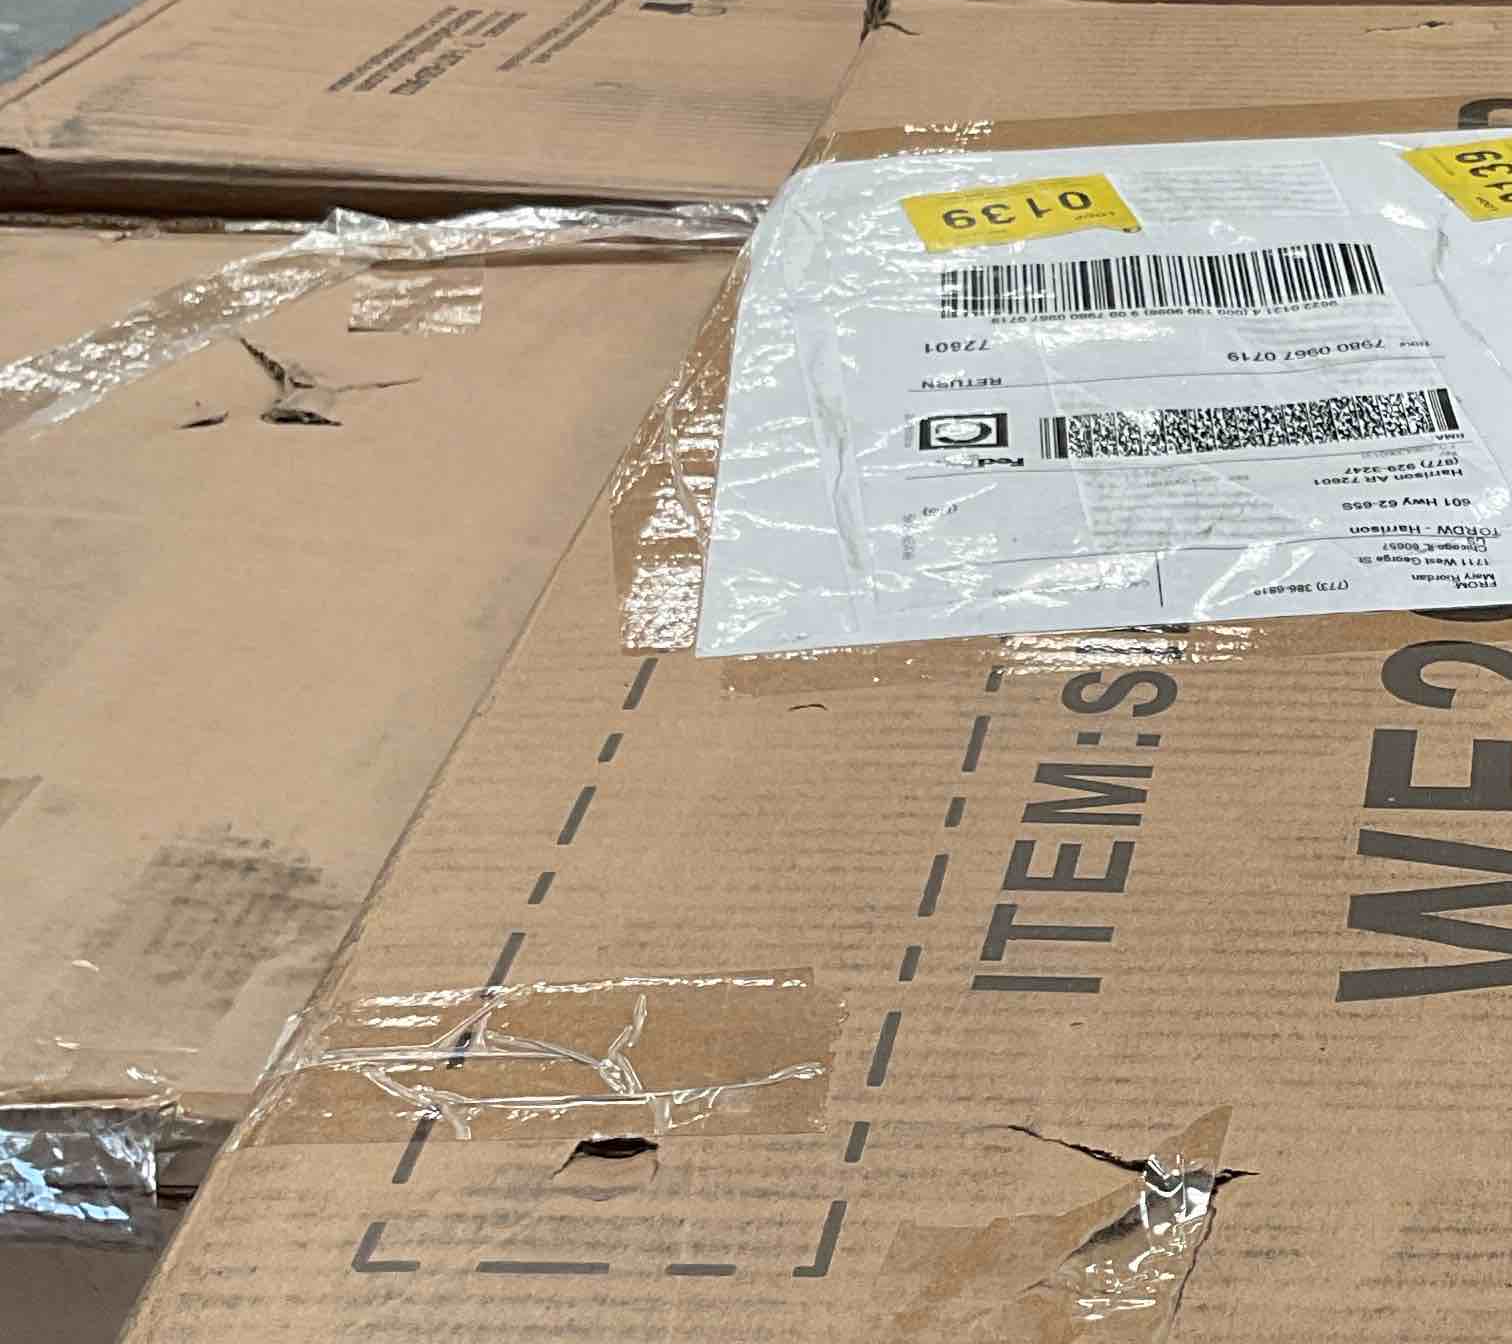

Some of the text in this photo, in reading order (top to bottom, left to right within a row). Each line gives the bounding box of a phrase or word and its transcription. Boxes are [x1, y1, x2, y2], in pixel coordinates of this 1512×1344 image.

[943, 190, 1092, 231] 0139
[1337, 338, 1384, 353] 7980
[1227, 352, 1276, 362] 0719
[1284, 346, 1331, 361] 0967
[1366, 475, 1392, 483] AR
[1395, 469, 1463, 481] Harrison
[1403, 497, 1437, 507] Hwy
[1443, 498, 1471, 506] 601
[1350, 524, 1421, 535] Harrison
[1376, 556, 1422, 566] George
[1425, 557, 1457, 566] West
[1461, 557, 1489, 566] 1711
[1465, 572, 1495, 581] Mary
[1317, 579, 1349, 592] (773)
[1455, 580, 1497, 589] FROM
[971, 644, 1188, 992] ITEM:S
